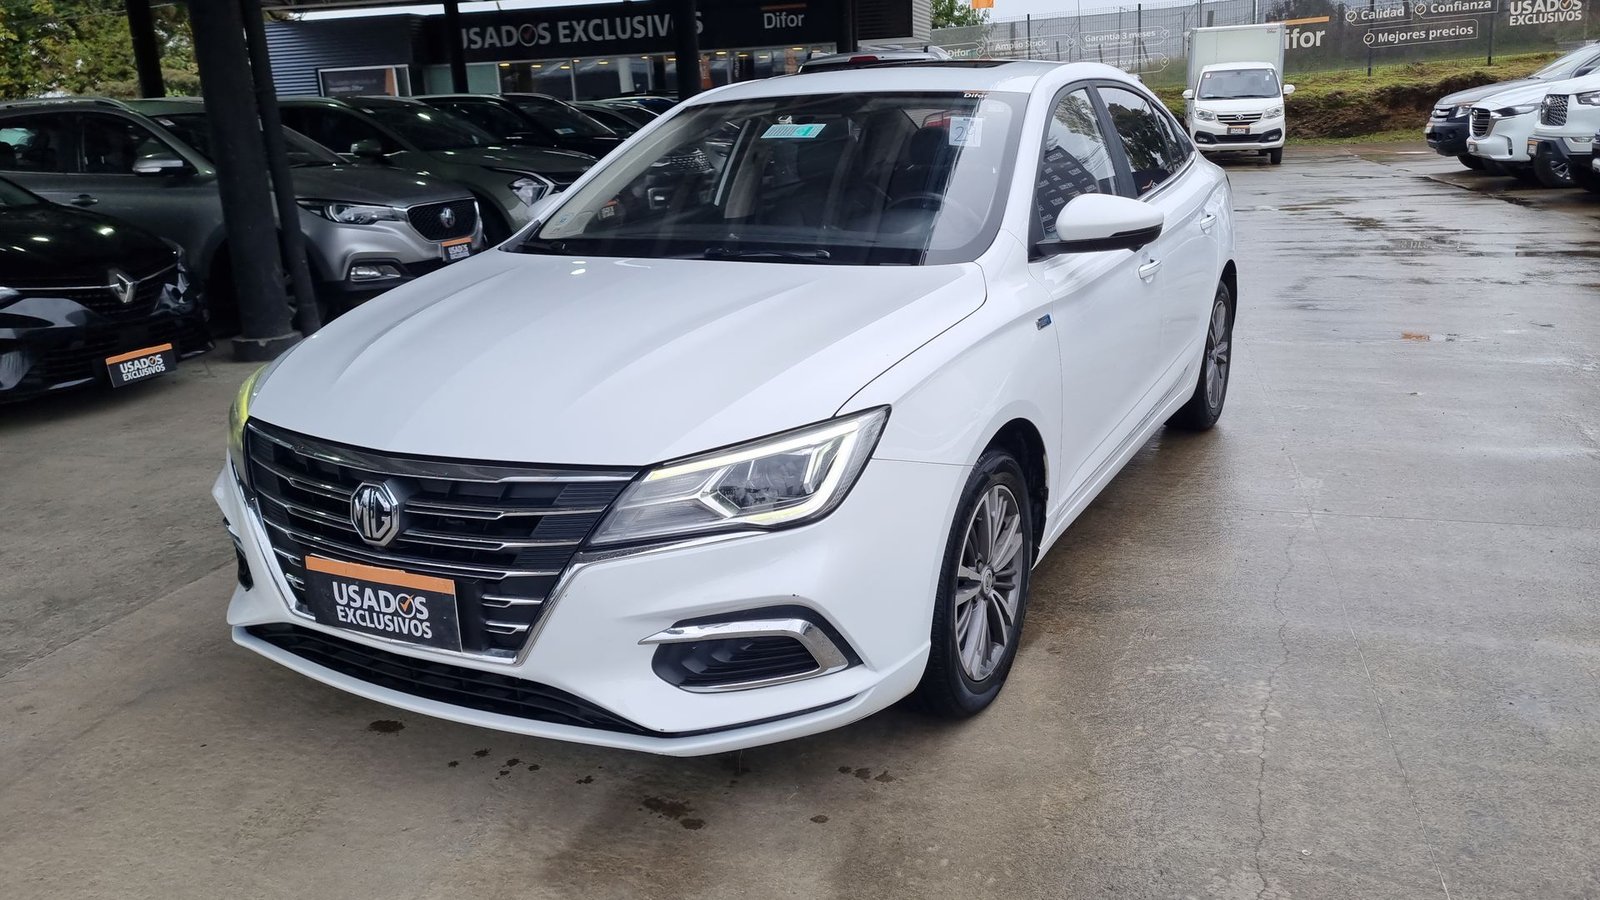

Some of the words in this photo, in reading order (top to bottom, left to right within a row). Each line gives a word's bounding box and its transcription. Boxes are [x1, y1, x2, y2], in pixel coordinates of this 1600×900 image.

[1361, 7, 1405, 20] Calidad
[1430, 0, 1491, 13] Confianza
[1510, 0, 1582, 15] USADOS
[763, 12, 805, 29] Difor
[1509, 10, 1582, 26] EXCLUSIVOS
[557, 11, 704, 43] EXCLUSIVS
[1377, 31, 1426, 43] Mejores
[1429, 25, 1473, 40] precios
[1284, 27, 1326, 49] ifor
[947, 48, 970, 58] Difor
[119, 354, 163, 373] USADOS
[122, 364, 165, 381] EXCLUSIVOS
[353, 485, 395, 539] MG
[332, 581, 430, 620] USADOS
[336, 605, 433, 639] EXCLUSIVOS
